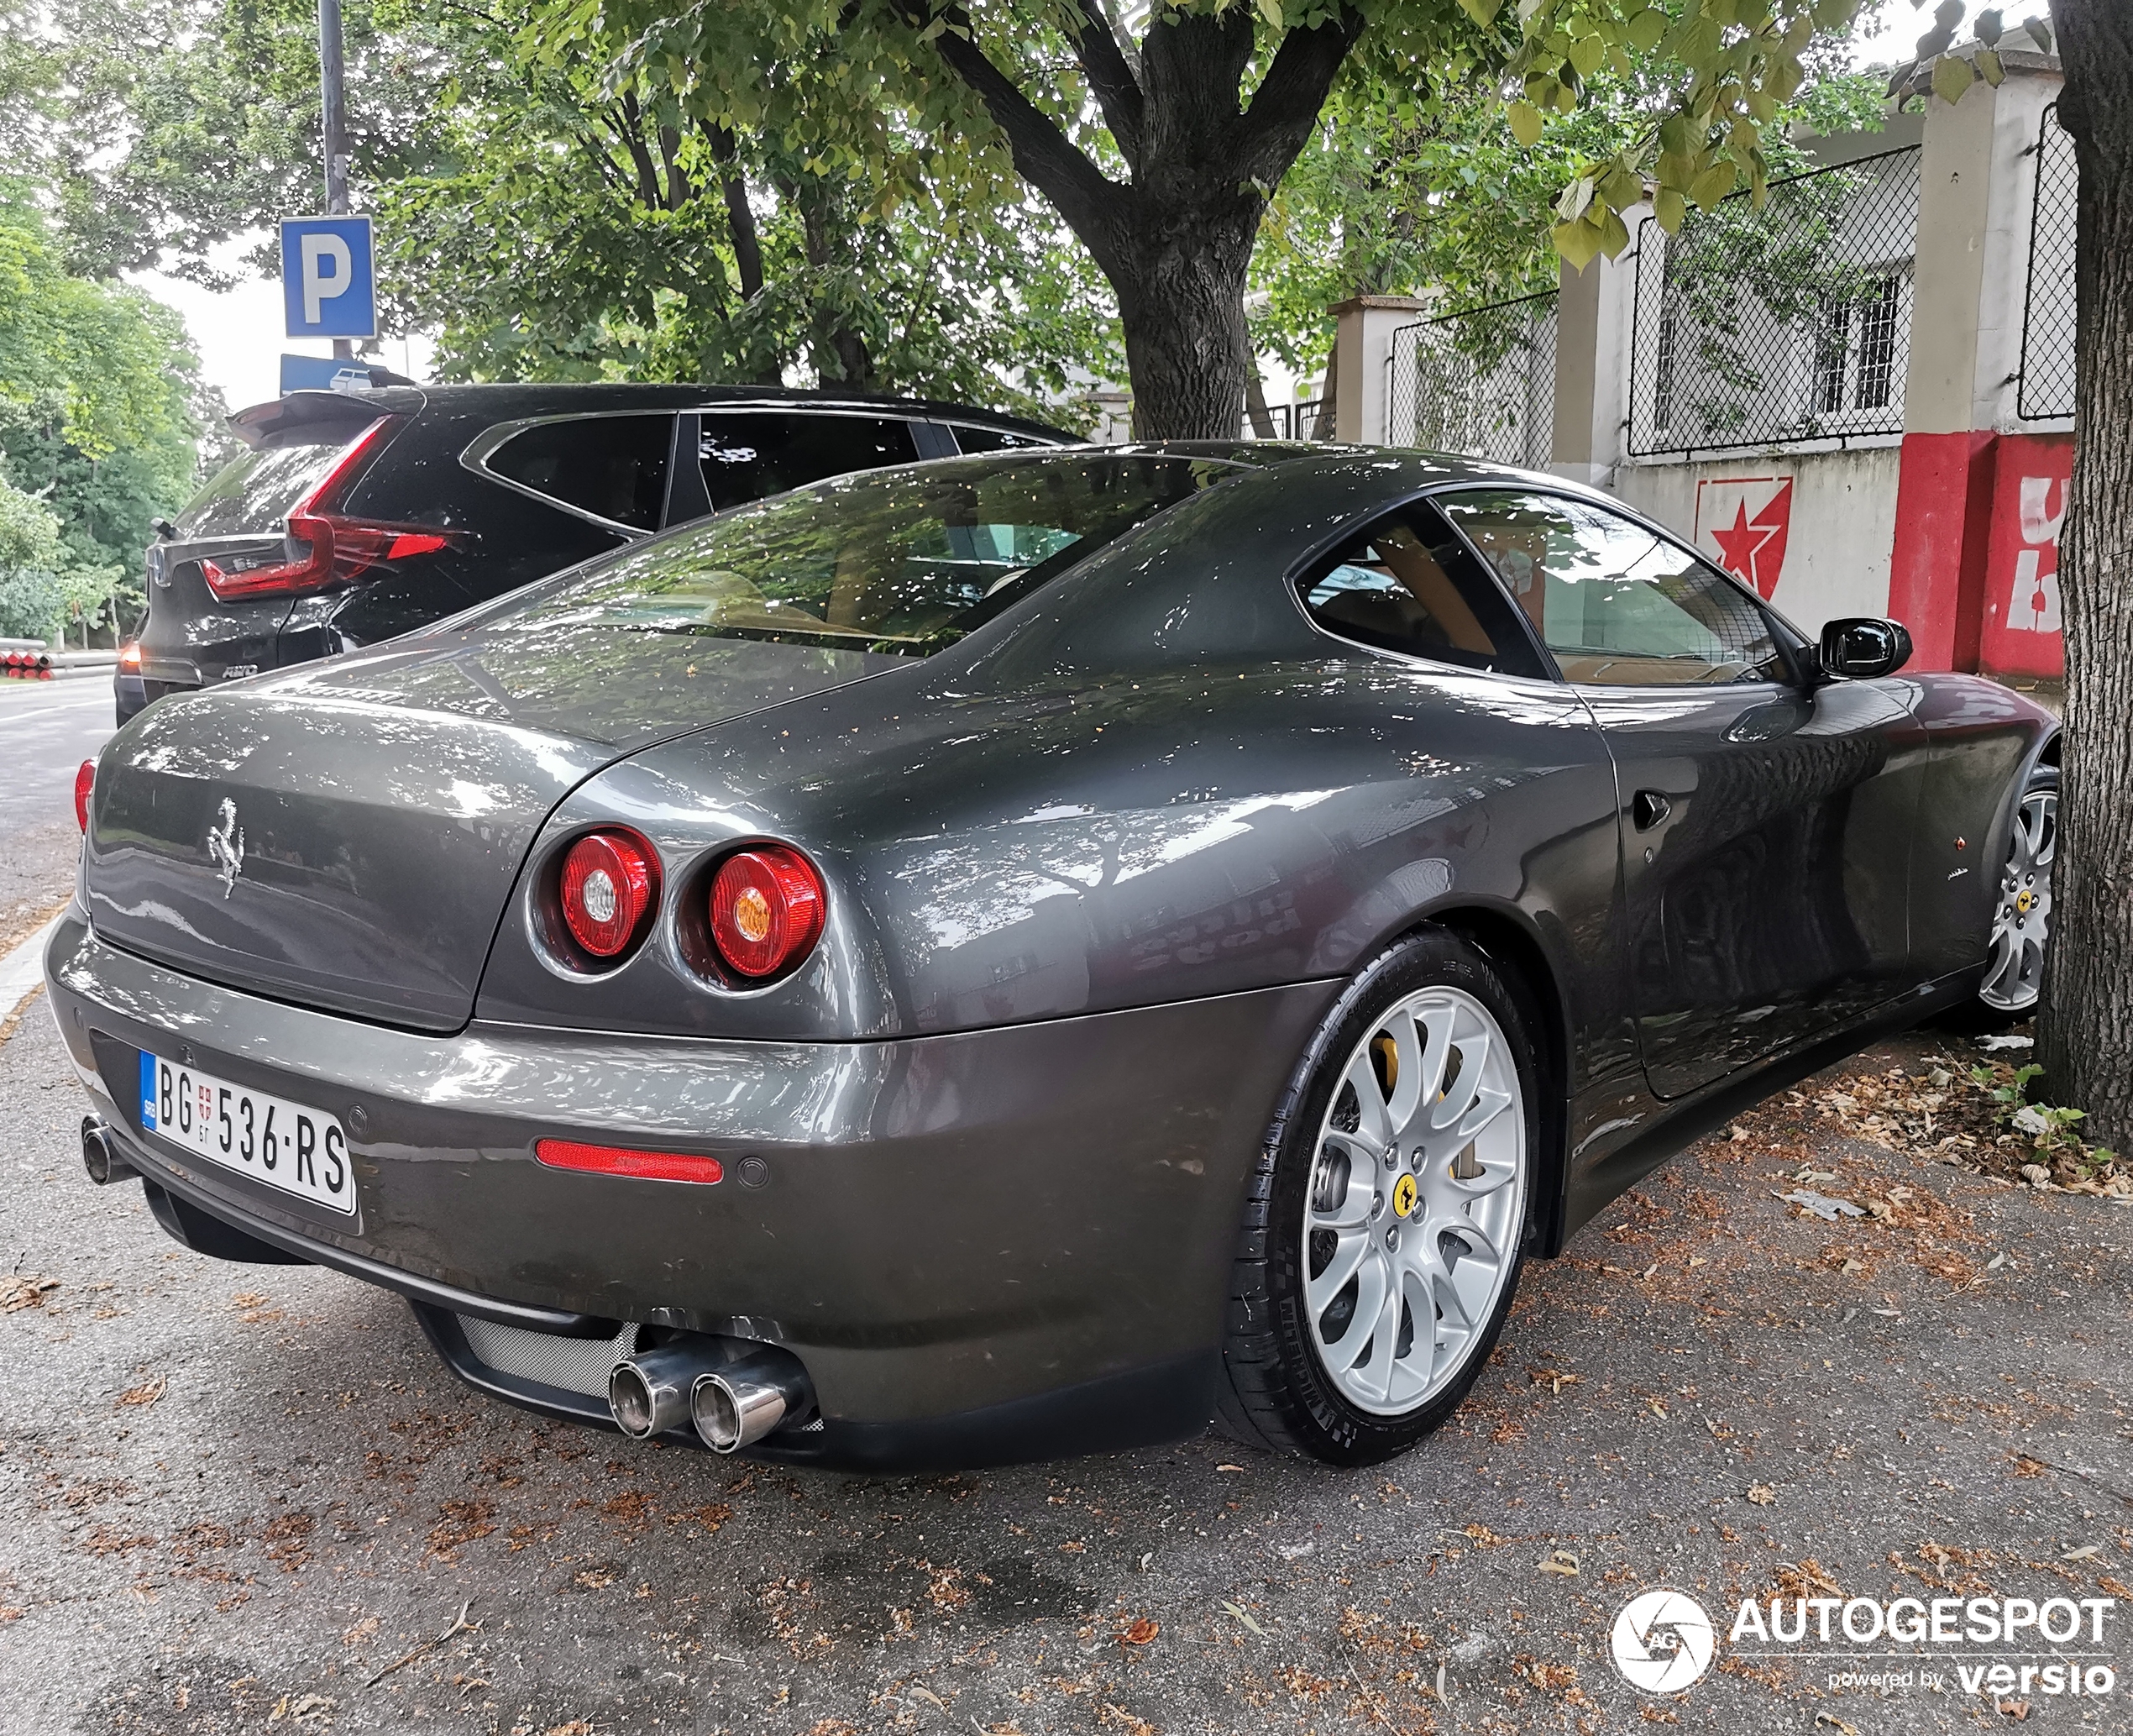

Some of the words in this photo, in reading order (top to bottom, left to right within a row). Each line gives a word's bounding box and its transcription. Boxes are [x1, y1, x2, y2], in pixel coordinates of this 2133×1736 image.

[301, 233, 351, 323] P
[223, 664, 258, 679] AWD
[144, 1099, 157, 1119] SRB
[160, 1062, 192, 1134] BG
